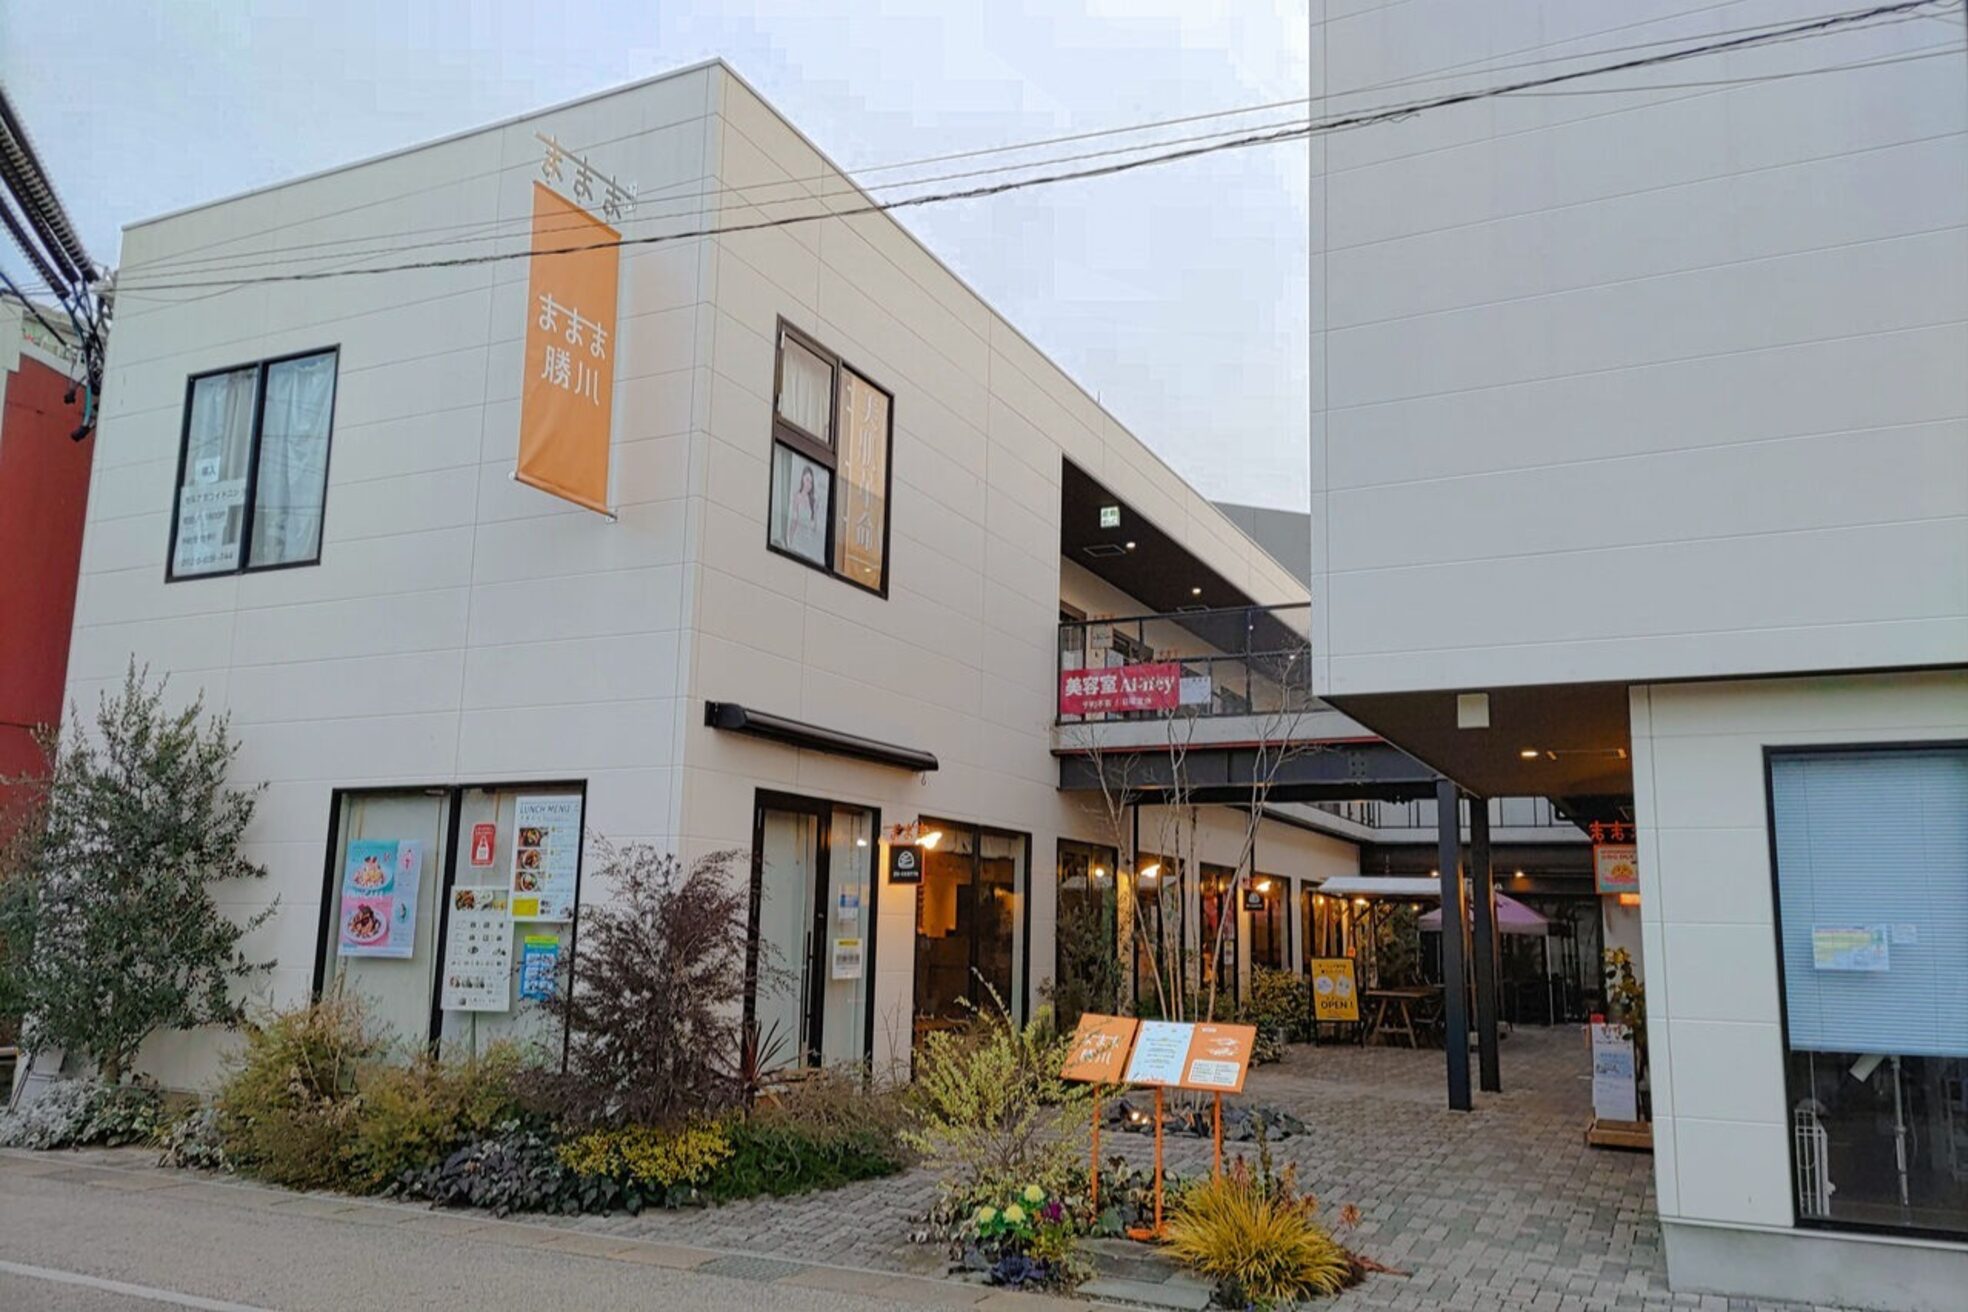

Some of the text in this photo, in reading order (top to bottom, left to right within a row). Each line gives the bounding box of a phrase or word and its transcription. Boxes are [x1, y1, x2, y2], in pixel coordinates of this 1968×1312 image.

[535, 132, 634, 220] ままま
[538, 292, 608, 361] ままま
[541, 345, 600, 406] 勝川
[1065, 675, 1117, 697] 美容室
[520, 804, 545, 815] LUNCH
[1589, 820, 1637, 841] まま
